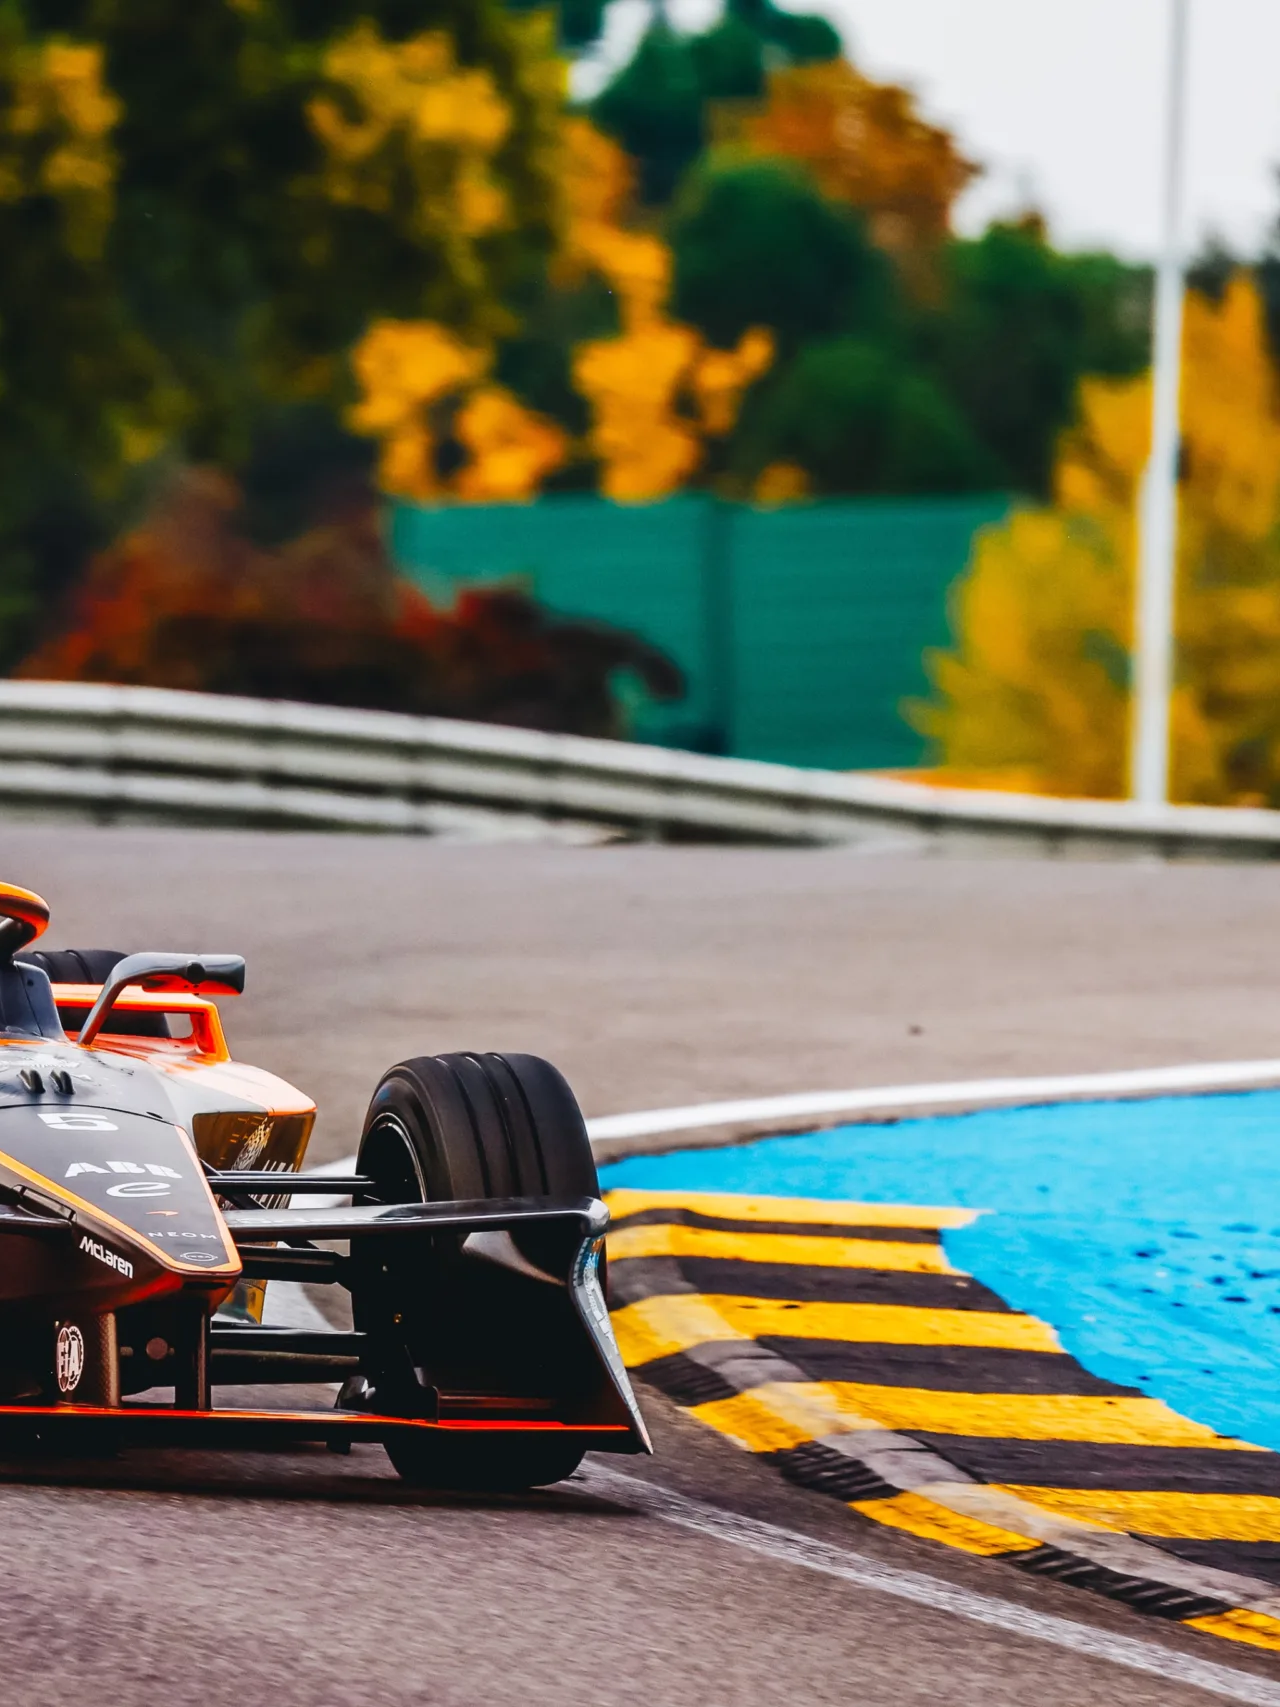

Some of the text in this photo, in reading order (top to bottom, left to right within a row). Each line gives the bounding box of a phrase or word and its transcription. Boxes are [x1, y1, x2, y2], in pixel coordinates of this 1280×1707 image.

[37, 1113, 119, 1131] 5
[64, 1160, 183, 1179] ABB
[147, 1231, 218, 1240] NEOM
[79, 1236, 134, 1279] McLaren
